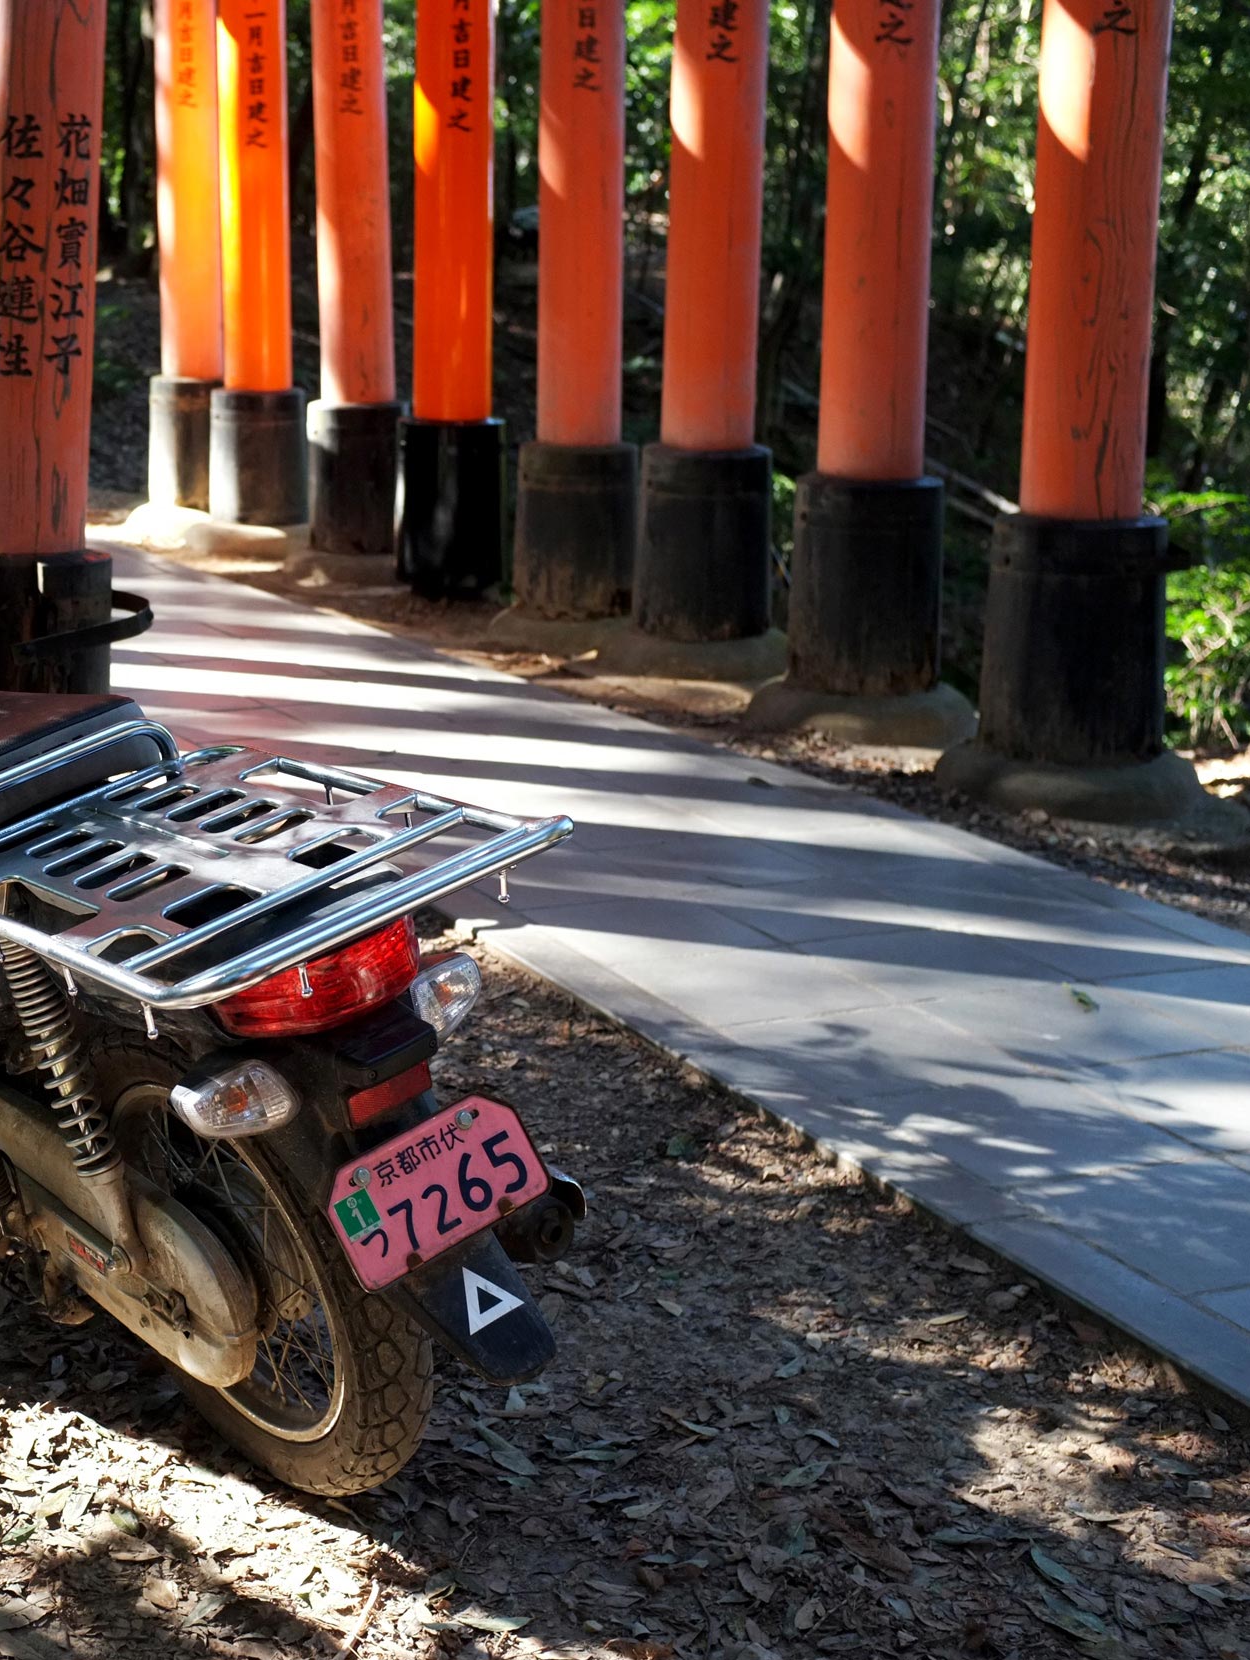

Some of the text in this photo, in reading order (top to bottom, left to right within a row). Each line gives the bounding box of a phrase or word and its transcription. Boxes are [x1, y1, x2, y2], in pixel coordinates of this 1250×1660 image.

[373, 1122, 466, 1187] 京都市伏
[386, 1129, 528, 1251] 7265
